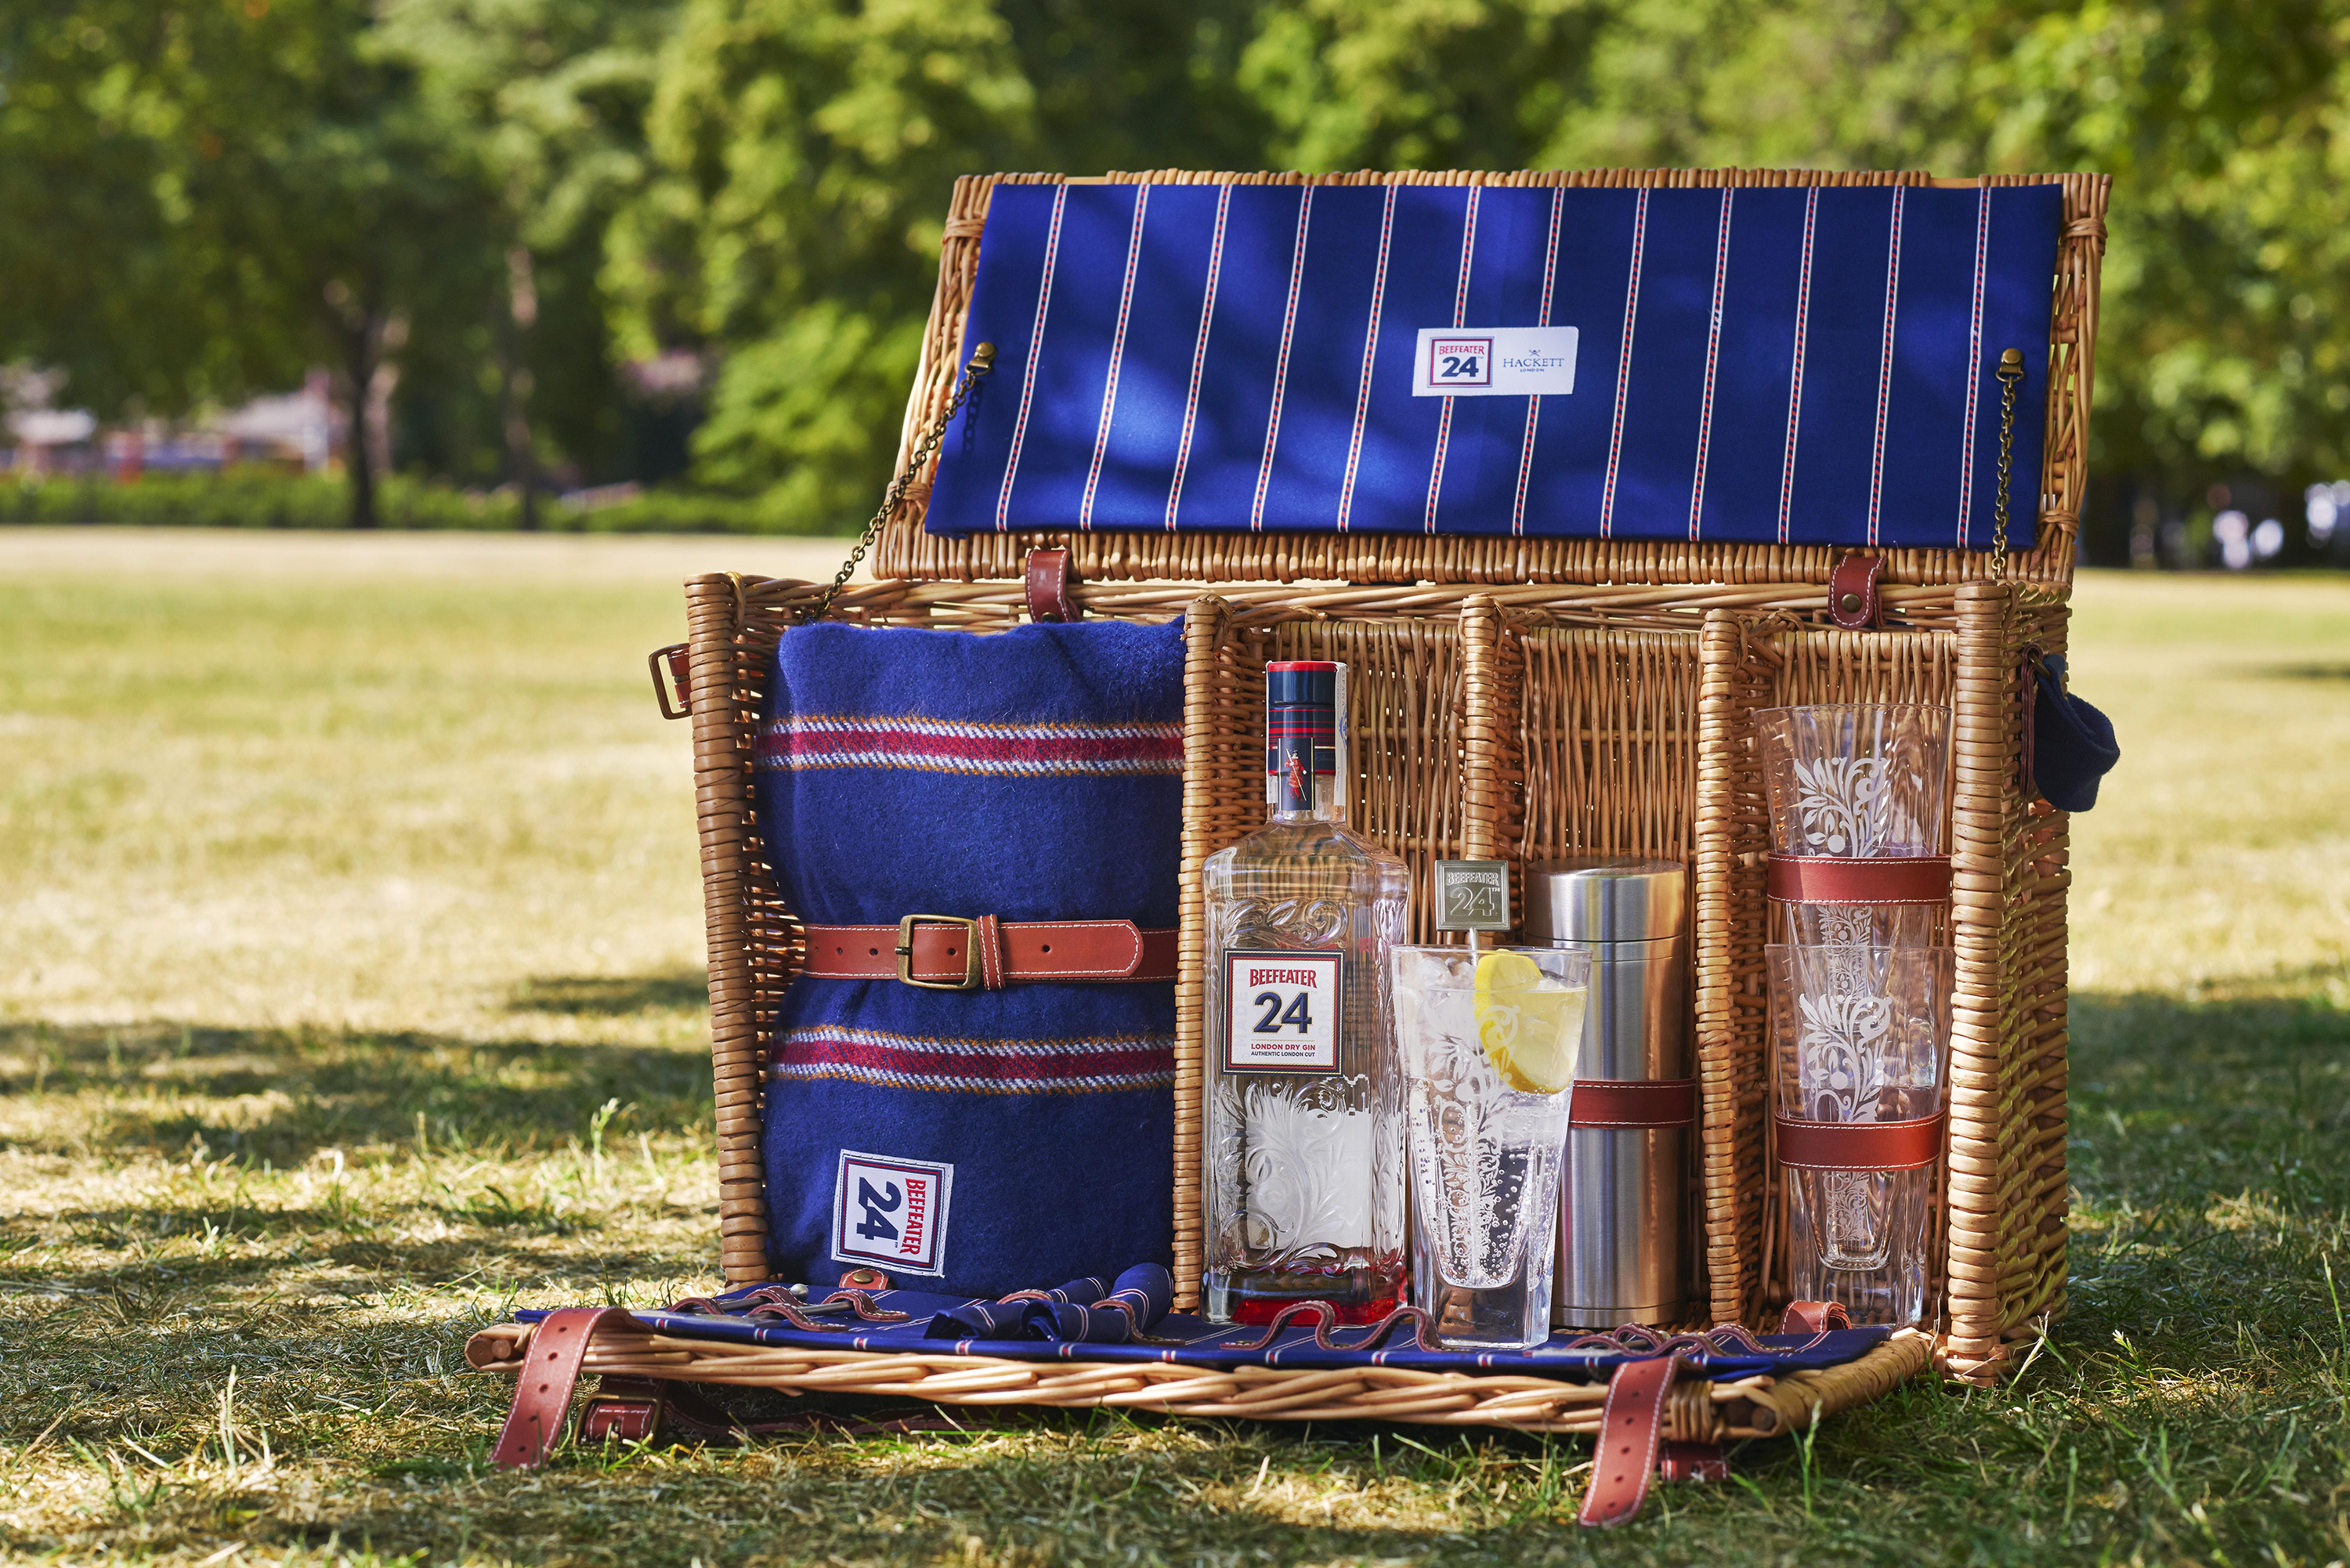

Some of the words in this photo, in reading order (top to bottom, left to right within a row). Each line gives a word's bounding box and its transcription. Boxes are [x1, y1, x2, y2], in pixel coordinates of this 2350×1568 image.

[1439, 345, 1484, 356] BEEFEATER
[1441, 356, 1479, 378] 24
[1503, 358, 1565, 367] HACKETT
[1446, 872, 1499, 887] BEEFEATER
[1449, 887, 1495, 916] 24
[1249, 969, 1318, 989] BEEFEATER
[1252, 990, 1314, 1035] 24
[856, 1176, 902, 1241] 24
[899, 1178, 927, 1255] BEEFEATER
